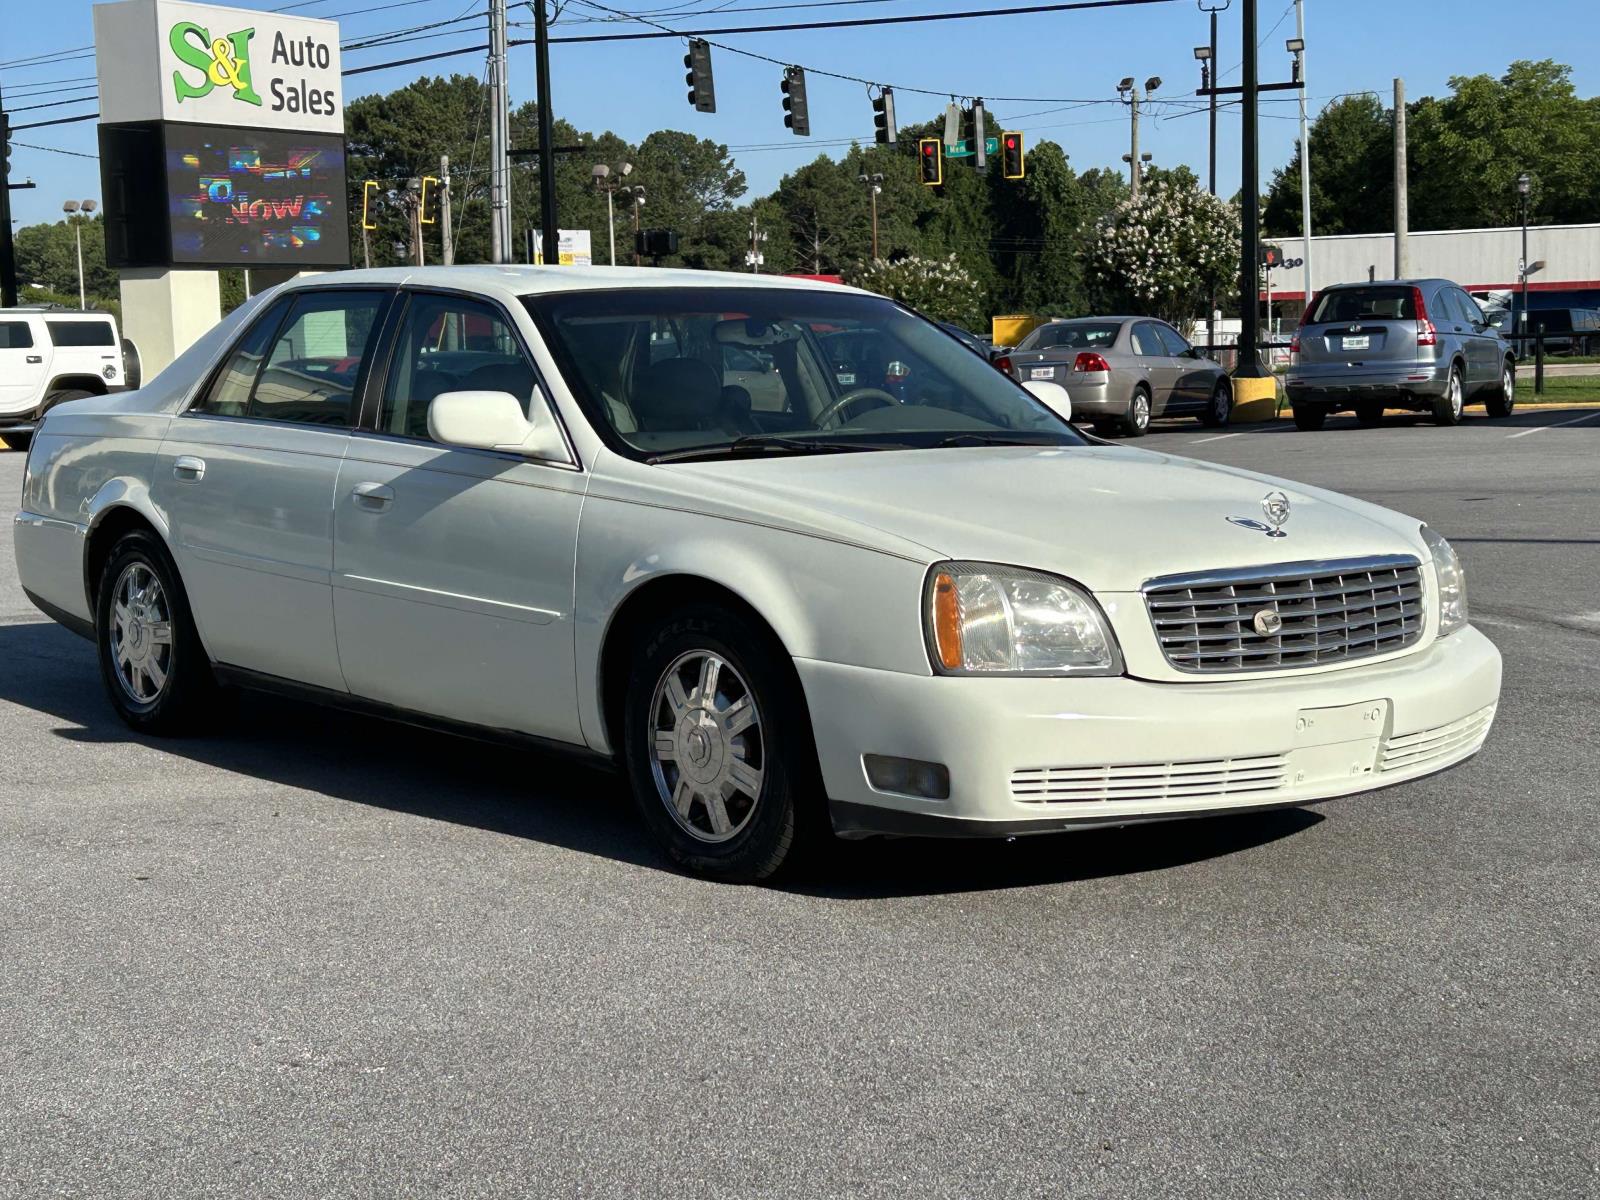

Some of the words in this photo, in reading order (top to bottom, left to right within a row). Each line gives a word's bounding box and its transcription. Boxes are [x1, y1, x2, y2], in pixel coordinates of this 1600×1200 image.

[169, 21, 262, 106] S&I
[271, 30, 330, 69] Auto
[270, 78, 335, 116] Sales
